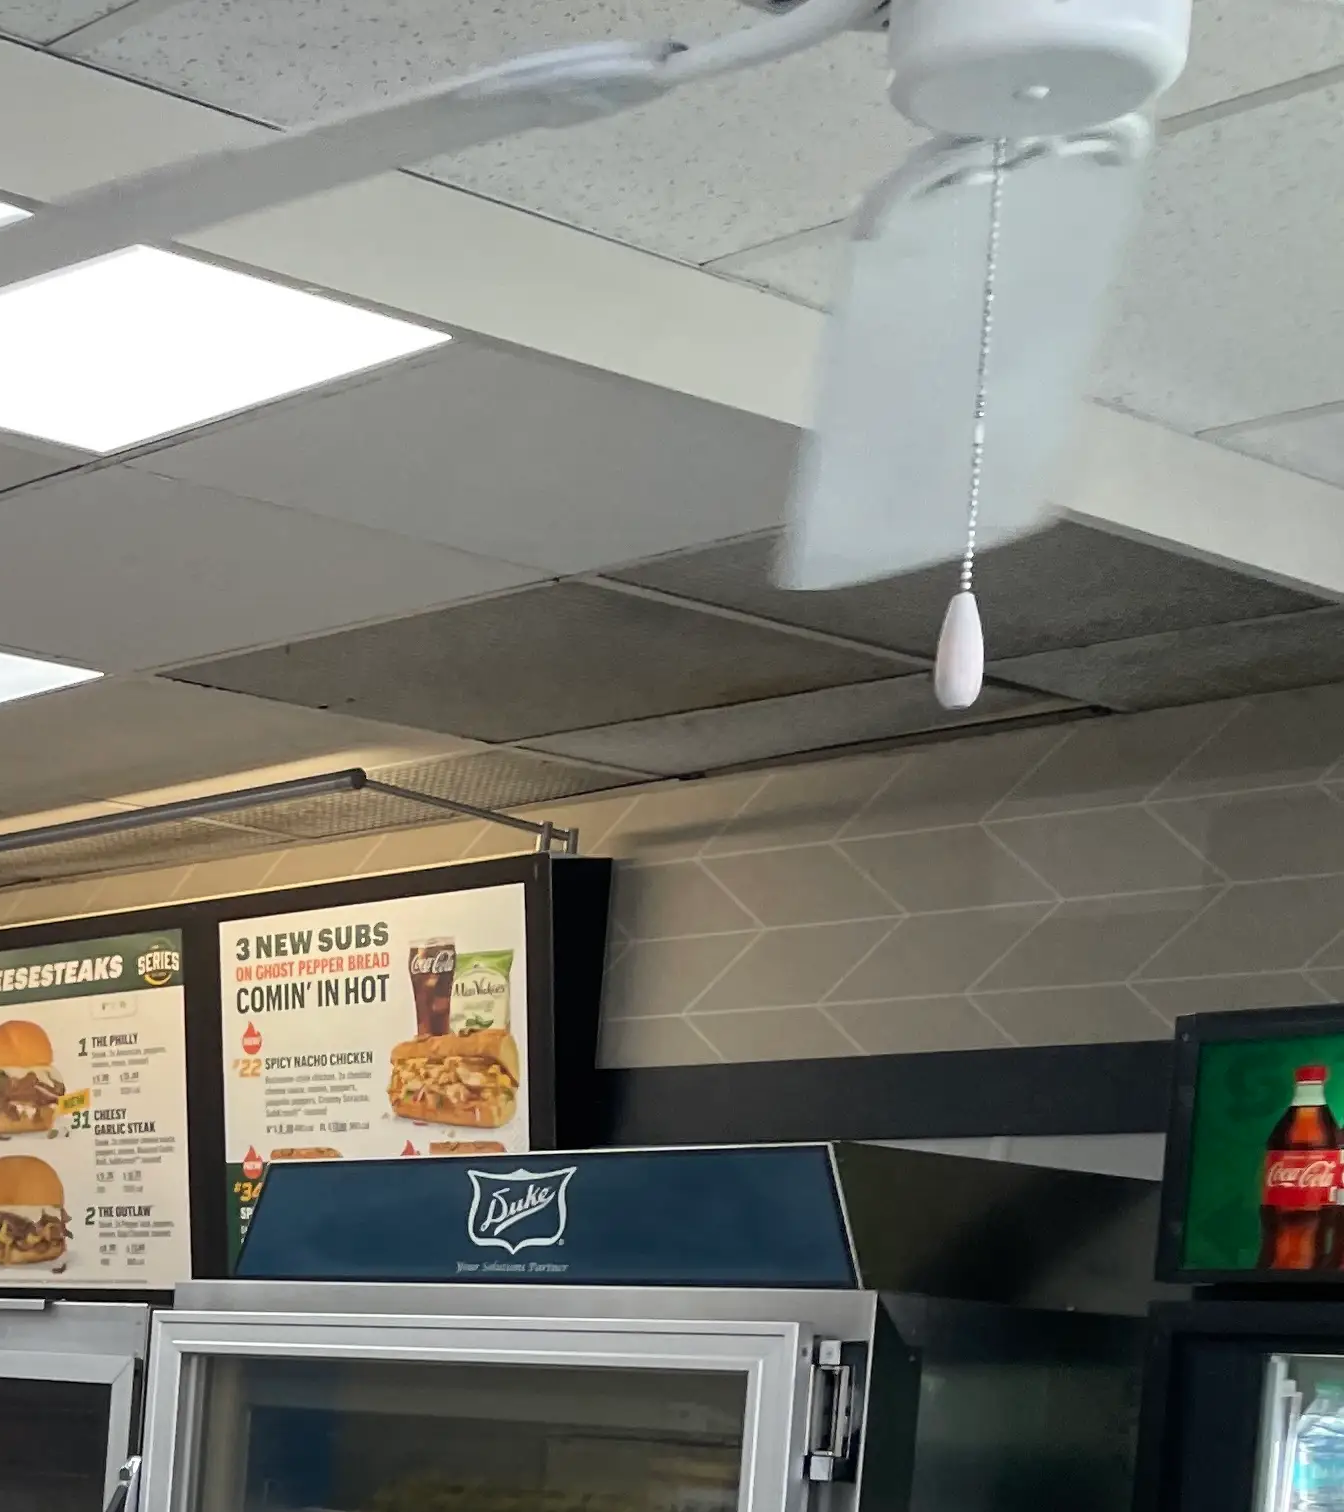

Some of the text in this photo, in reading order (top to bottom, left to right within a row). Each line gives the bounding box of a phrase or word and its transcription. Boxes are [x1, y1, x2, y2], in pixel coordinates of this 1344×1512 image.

[236, 921, 389, 961] 3 NEW SUBS
[137, 951, 180, 977] SERIES
[236, 952, 390, 982] ON GHOST PEPPER BREAD
[237, 974, 390, 1014] COMIN' IN HOT
[78, 1033, 139, 1057] 1 THE PHILLY
[265, 1057, 292, 1071] SPICY
[294, 1054, 328, 1069] NACHO
[330, 1051, 373, 1066] CHICKEN
[71, 1109, 127, 1130] 31 CHEESY
[94, 1121, 156, 1136] GARLIC STEAK
[85, 1205, 151, 1226] 2 THE OUTLAW
[480, 1183, 555, 1234] Duke
